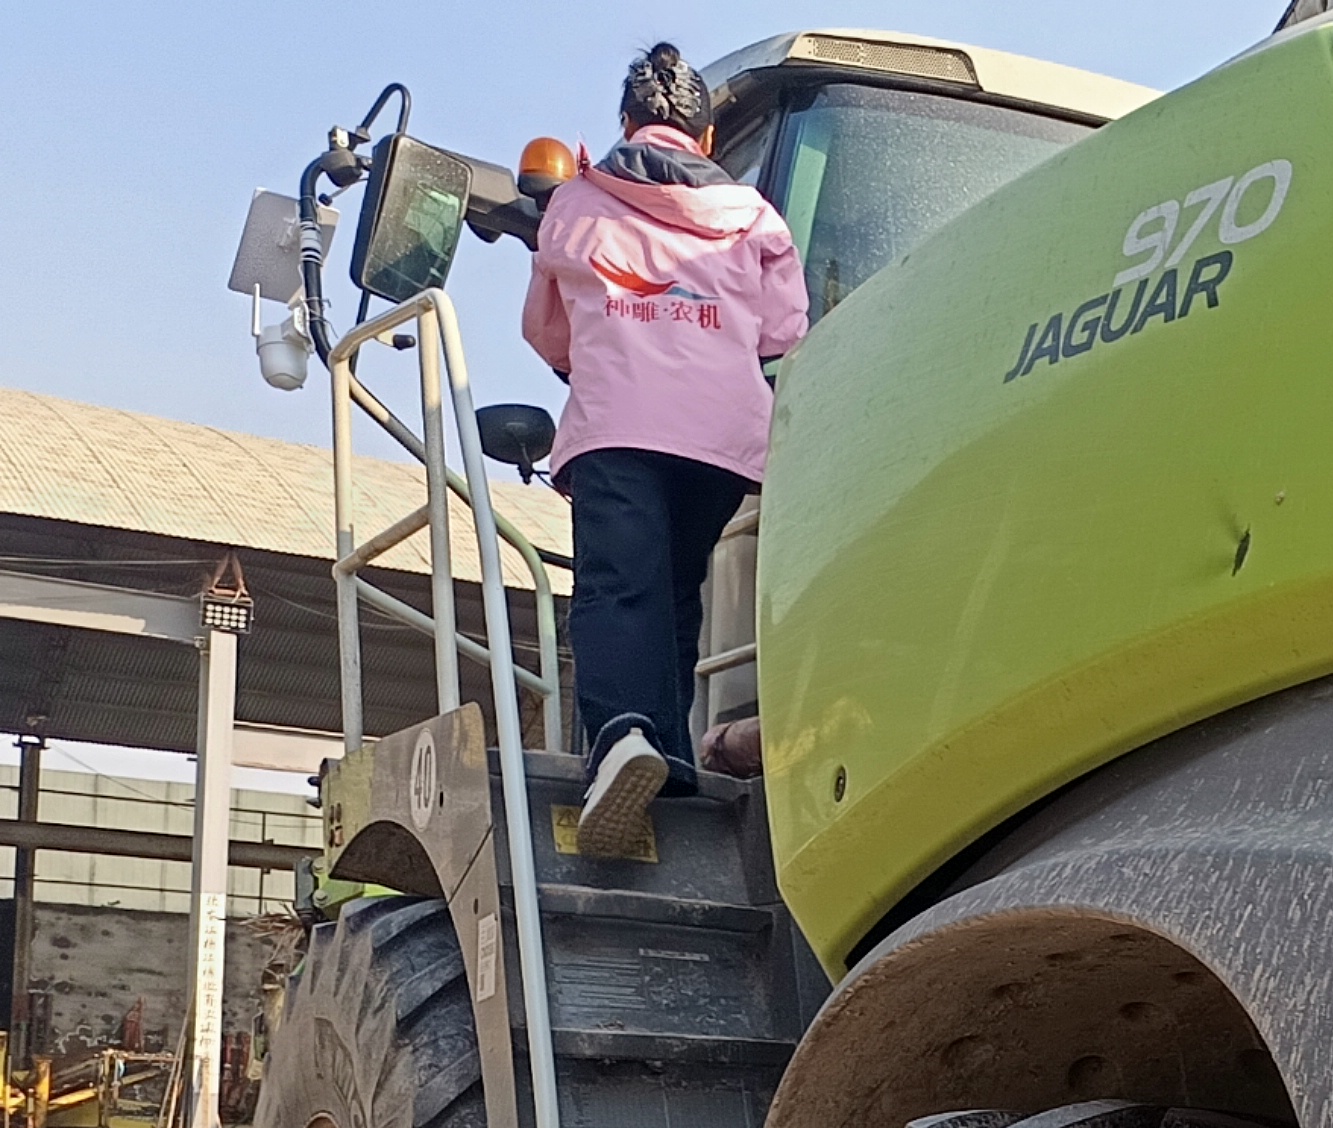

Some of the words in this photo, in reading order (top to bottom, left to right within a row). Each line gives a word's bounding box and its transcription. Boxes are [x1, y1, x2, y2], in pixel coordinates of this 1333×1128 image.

[1112, 158, 1293, 288] 970
[1002, 250, 1234, 385] JAGUAR
[413, 744, 432, 810] 40
